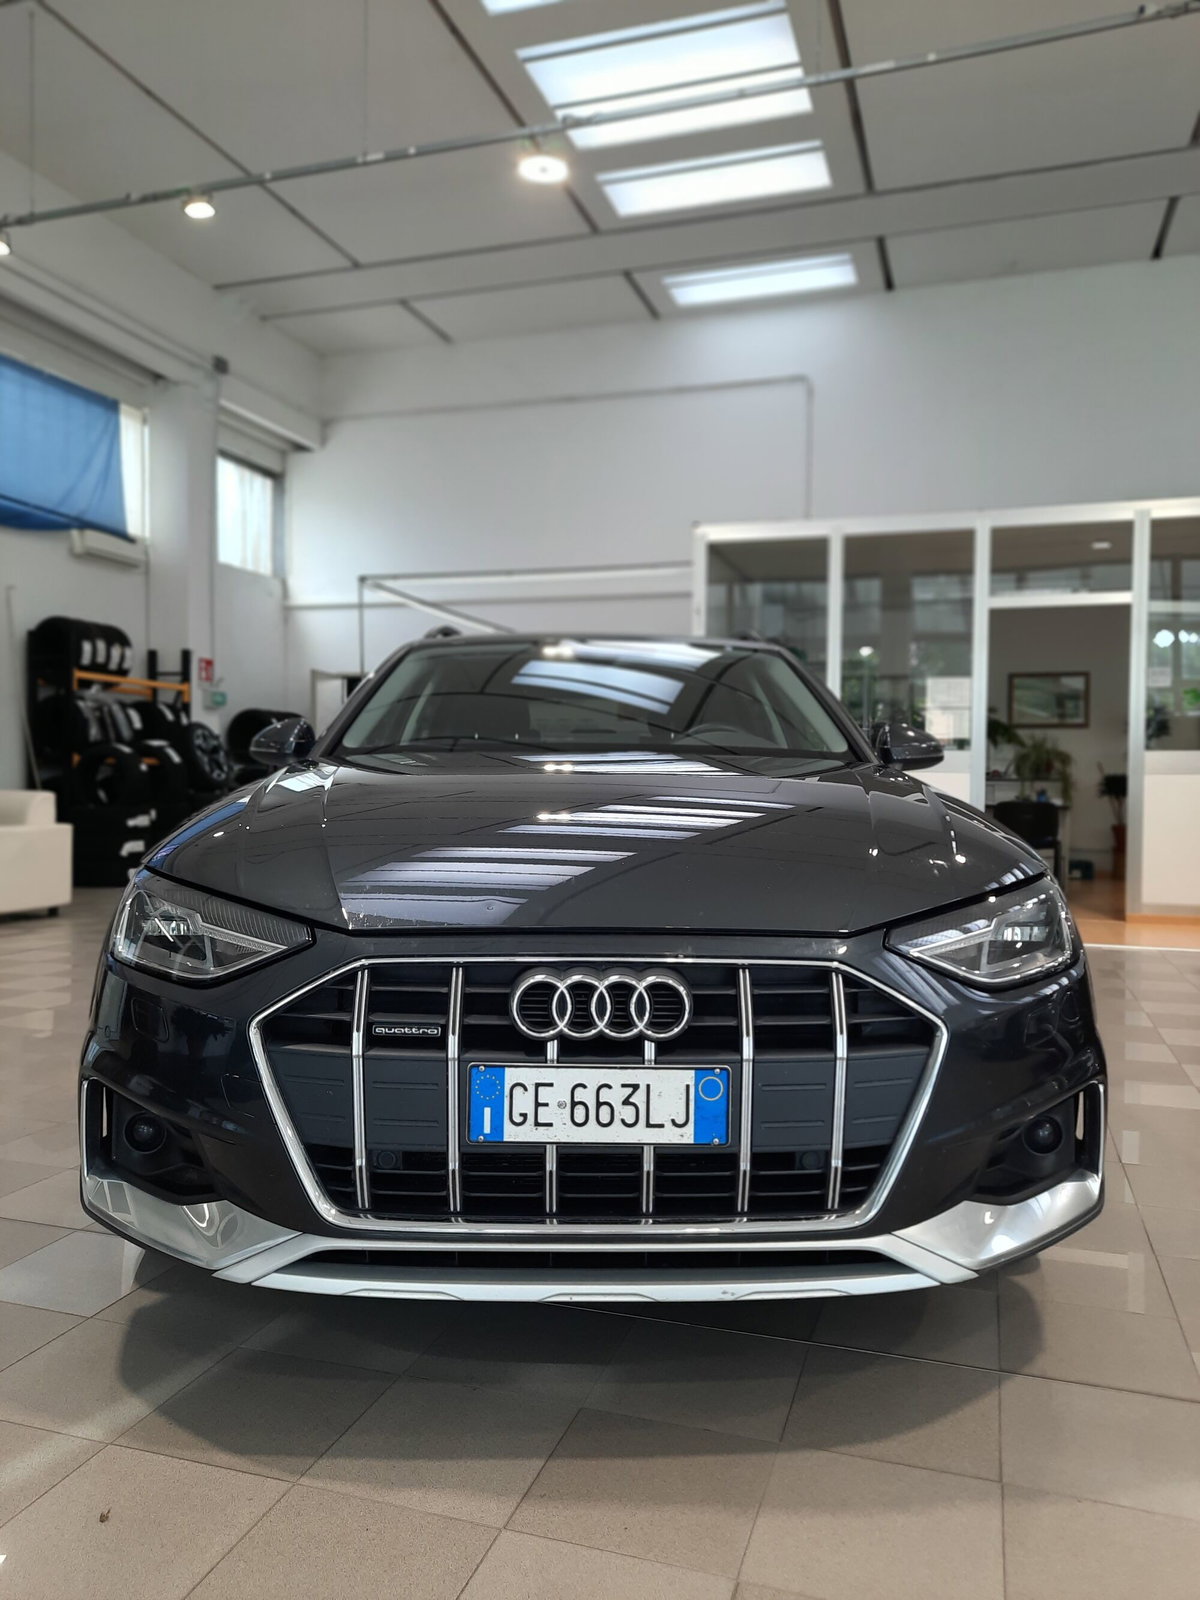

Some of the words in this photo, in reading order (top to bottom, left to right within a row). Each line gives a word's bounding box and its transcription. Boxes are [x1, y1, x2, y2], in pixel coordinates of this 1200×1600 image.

[375, 1027, 438, 1035] quattro
[508, 1082, 554, 1128] GE
[570, 1082, 690, 1129] 663LJ
[483, 1107, 491, 1134] I
